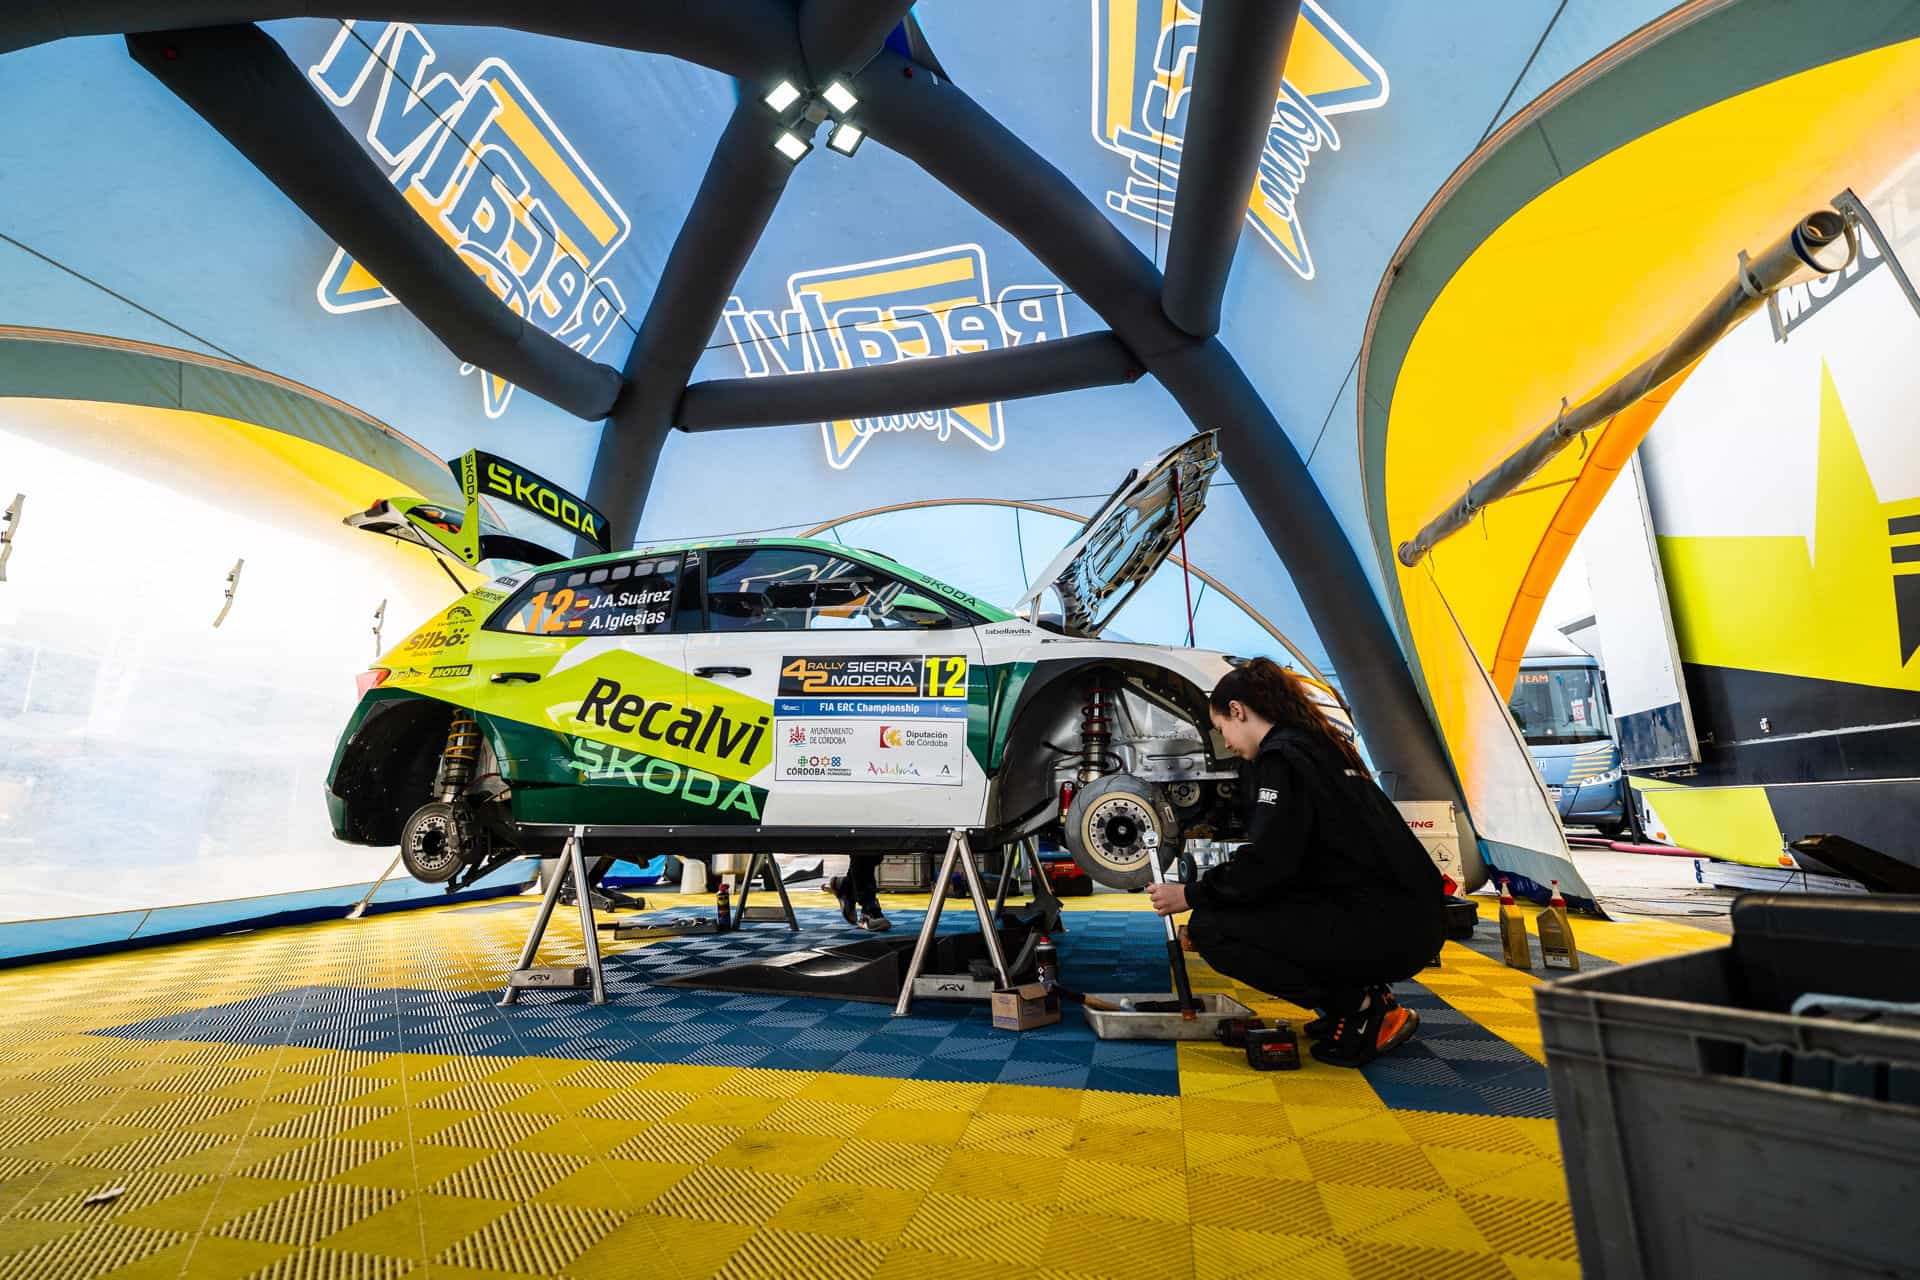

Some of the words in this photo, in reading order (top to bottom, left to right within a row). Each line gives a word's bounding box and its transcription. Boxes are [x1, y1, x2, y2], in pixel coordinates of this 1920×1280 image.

[527, 589, 575, 633] 12
[588, 610, 666, 631] A.Iglesias
[433, 665, 471, 677] MOTUL
[807, 662, 846, 671] RALLY
[847, 661, 915, 673] SIERRA
[831, 675, 914, 686] MORENA
[926, 656, 967, 697] 12
[819, 702, 834, 712] FIA
[837, 702, 855, 712] ERC
[857, 702, 920, 714] Championship
[576, 677, 770, 765] Recalvi
[809, 727, 855, 735] AYUNTAMIENTO
[937, 983, 966, 992] ARV
